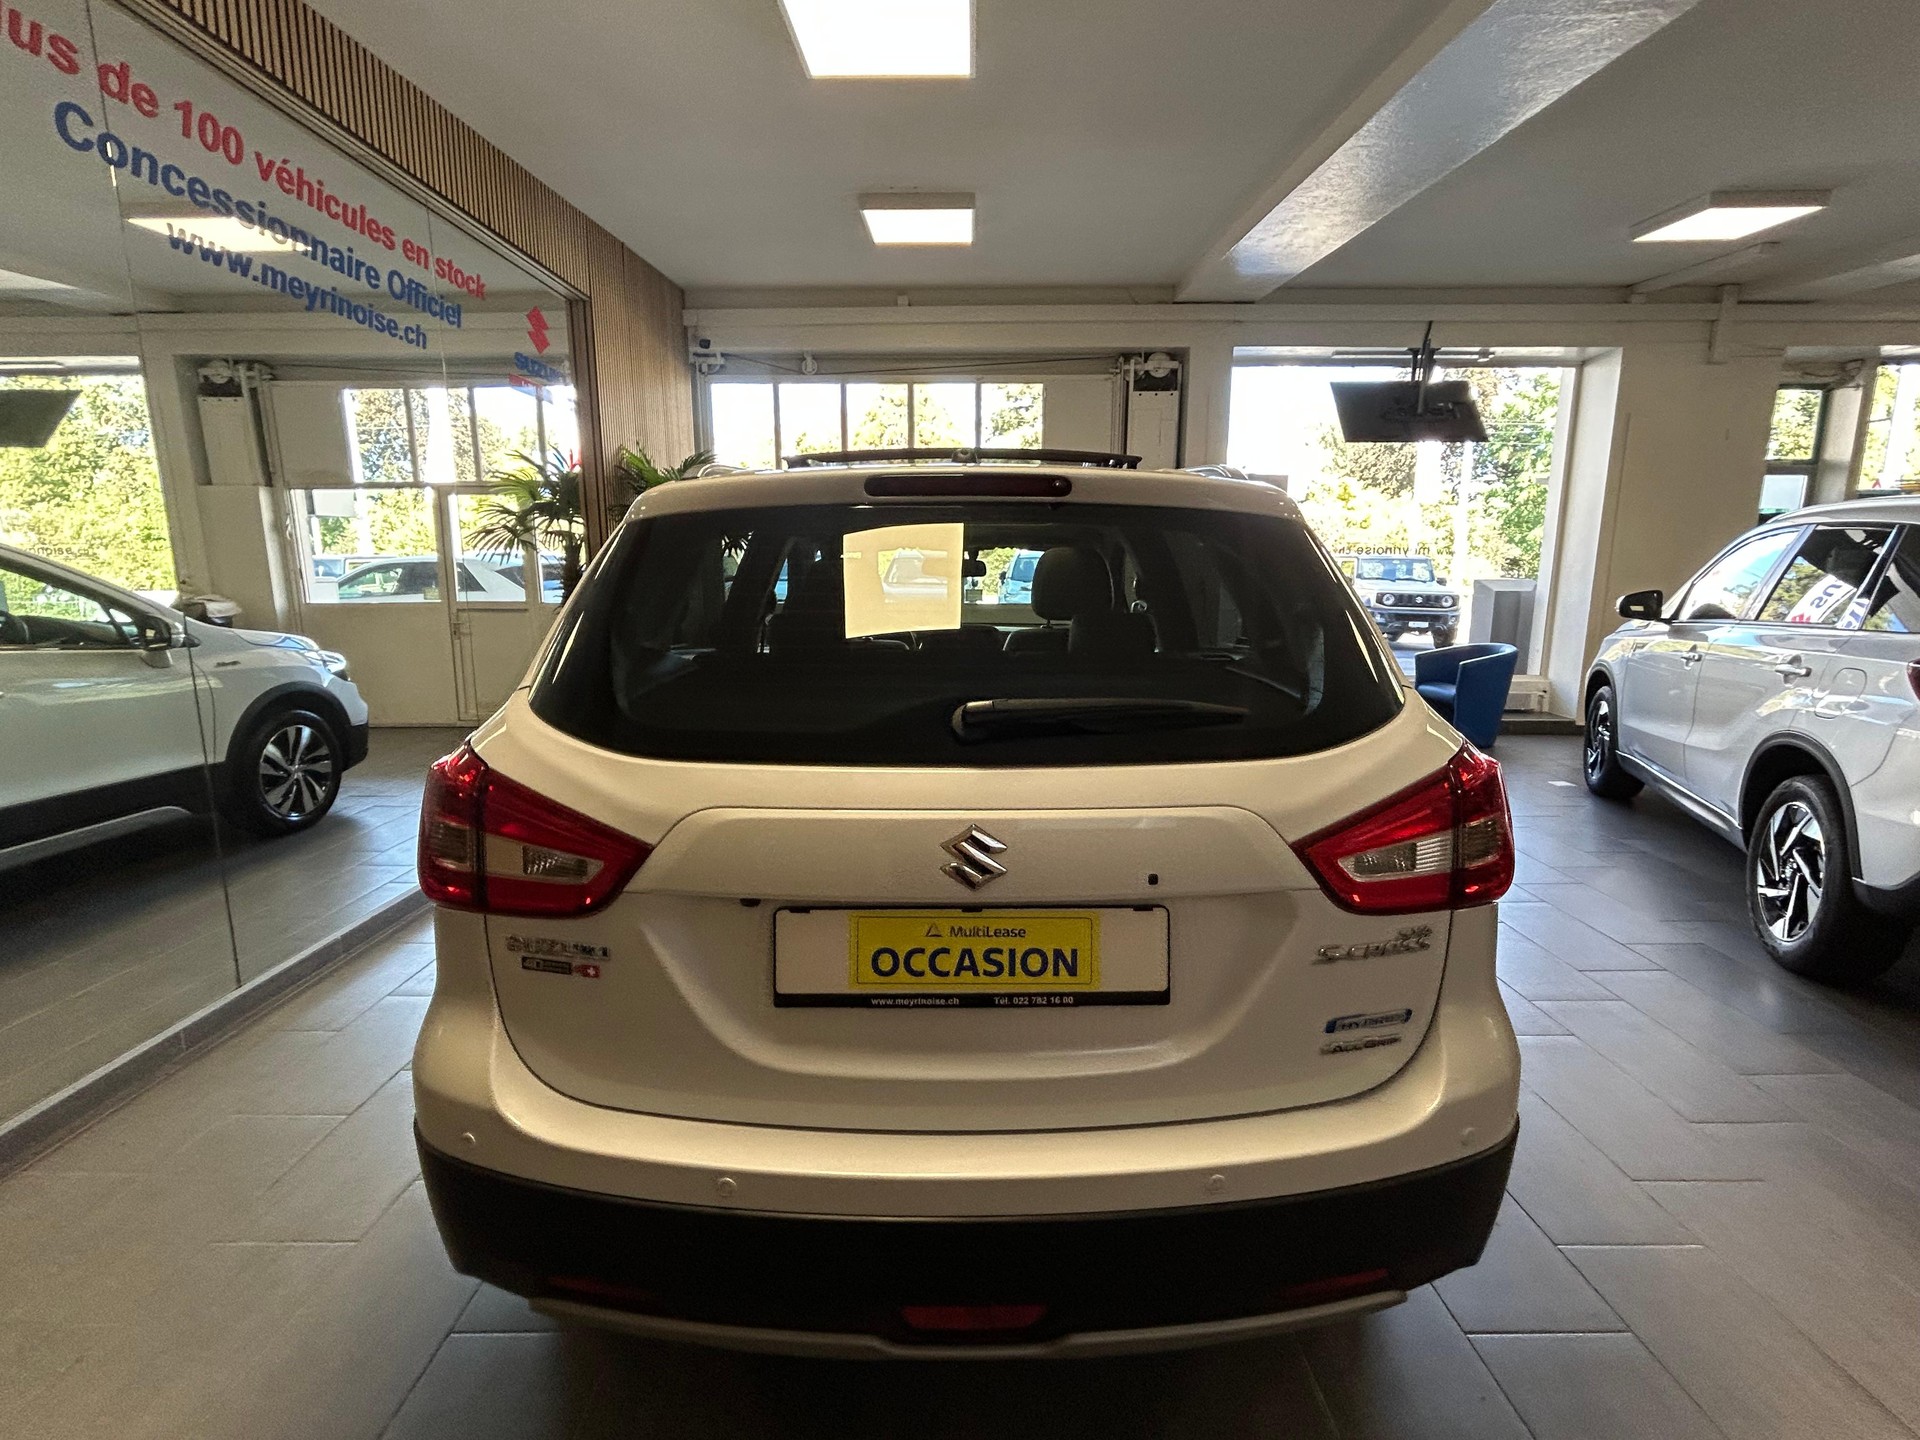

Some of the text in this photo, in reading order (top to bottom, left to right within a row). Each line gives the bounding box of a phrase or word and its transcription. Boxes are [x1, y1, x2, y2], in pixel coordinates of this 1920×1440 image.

[0, 0, 486, 299] us de 100 véhicules en stock
[54, 101, 461, 328] Concessionnaire Officiel
[166, 222, 427, 350] www.meyrinoise.ch
[871, 947, 1078, 977] OCCASION
[950, 926, 1026, 938] MultiLease
[871, 998, 960, 1007] www.meyrinoise.ch
[1013, 997, 1029, 1005] 022
